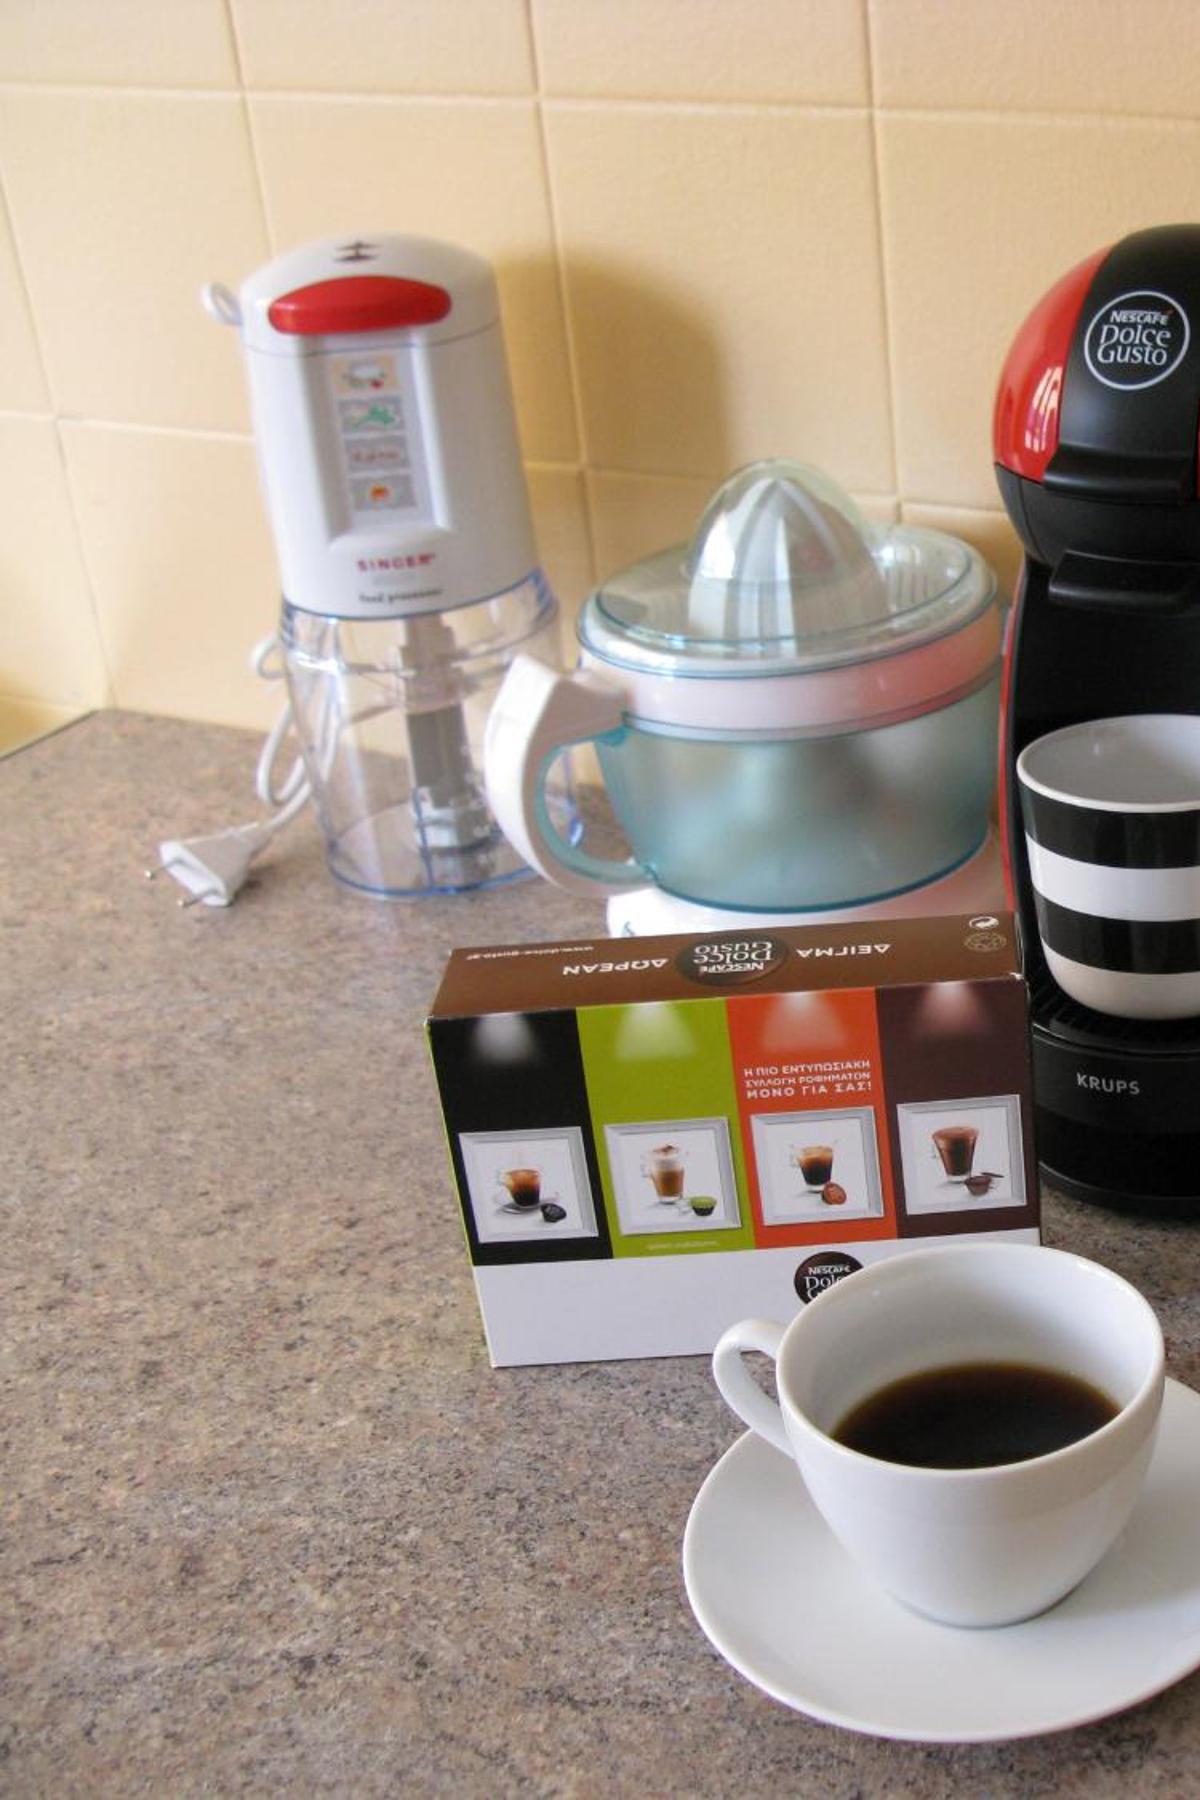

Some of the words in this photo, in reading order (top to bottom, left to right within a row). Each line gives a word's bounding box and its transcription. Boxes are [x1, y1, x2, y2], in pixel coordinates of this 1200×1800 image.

[1100, 324, 1171, 347] Dolce
[1097, 343, 1168, 366] Gusto
[693, 940, 773, 954] Gusto
[796, 943, 892, 959] ΔΕΙΓΜΑ
[693, 949, 774, 964] Dolce
[562, 958, 670, 976] ΔΩΡΕΑΝ
[1076, 1071, 1140, 1095] KRUPS
